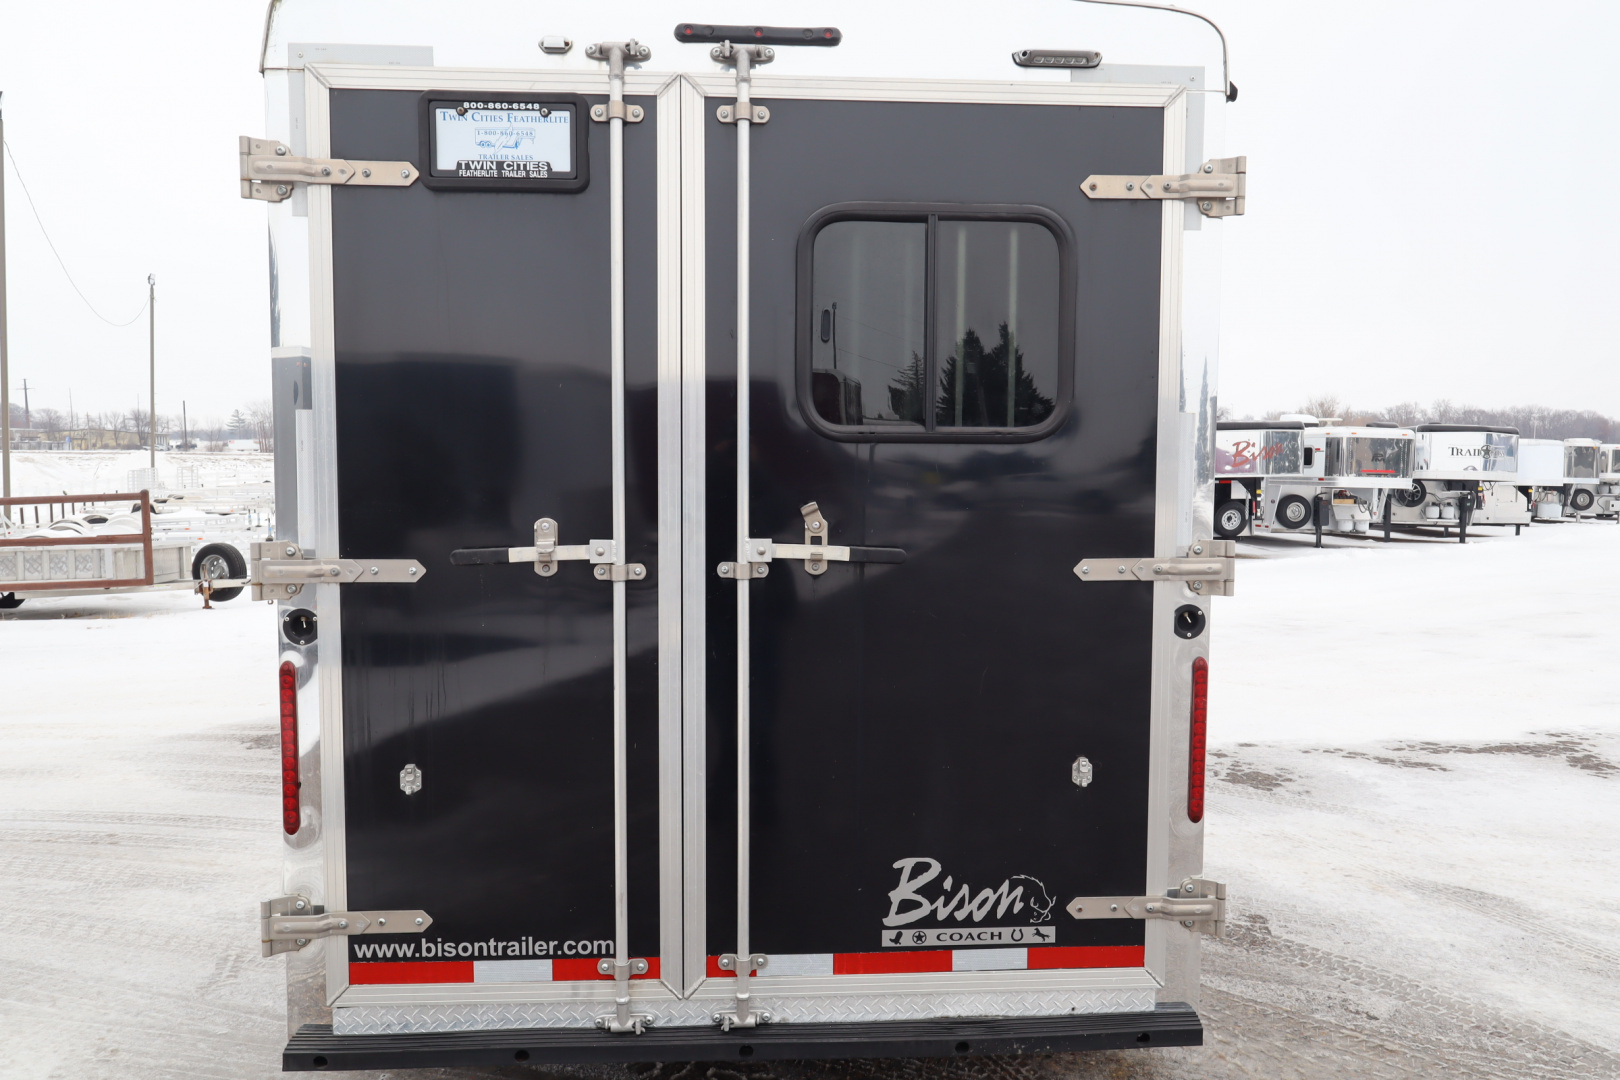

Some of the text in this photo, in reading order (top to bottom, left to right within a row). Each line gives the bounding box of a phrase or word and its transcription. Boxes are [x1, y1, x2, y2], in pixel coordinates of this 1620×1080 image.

[463, 101, 540, 110] 800-860-6548
[440, 111, 569, 124] TWIN CITIES FEATHERLITE
[478, 153, 509, 161] TRAILER
[459, 160, 548, 171] TWIN CITIES
[459, 170, 498, 178] FEATHERLITE
[502, 170, 526, 178] TRAILER
[1232, 440, 1285, 468] Bison
[882, 857, 1025, 927] Bison
[936, 931, 1002, 942] COACH
[353, 936, 615, 959] www.bisontrailer.com
